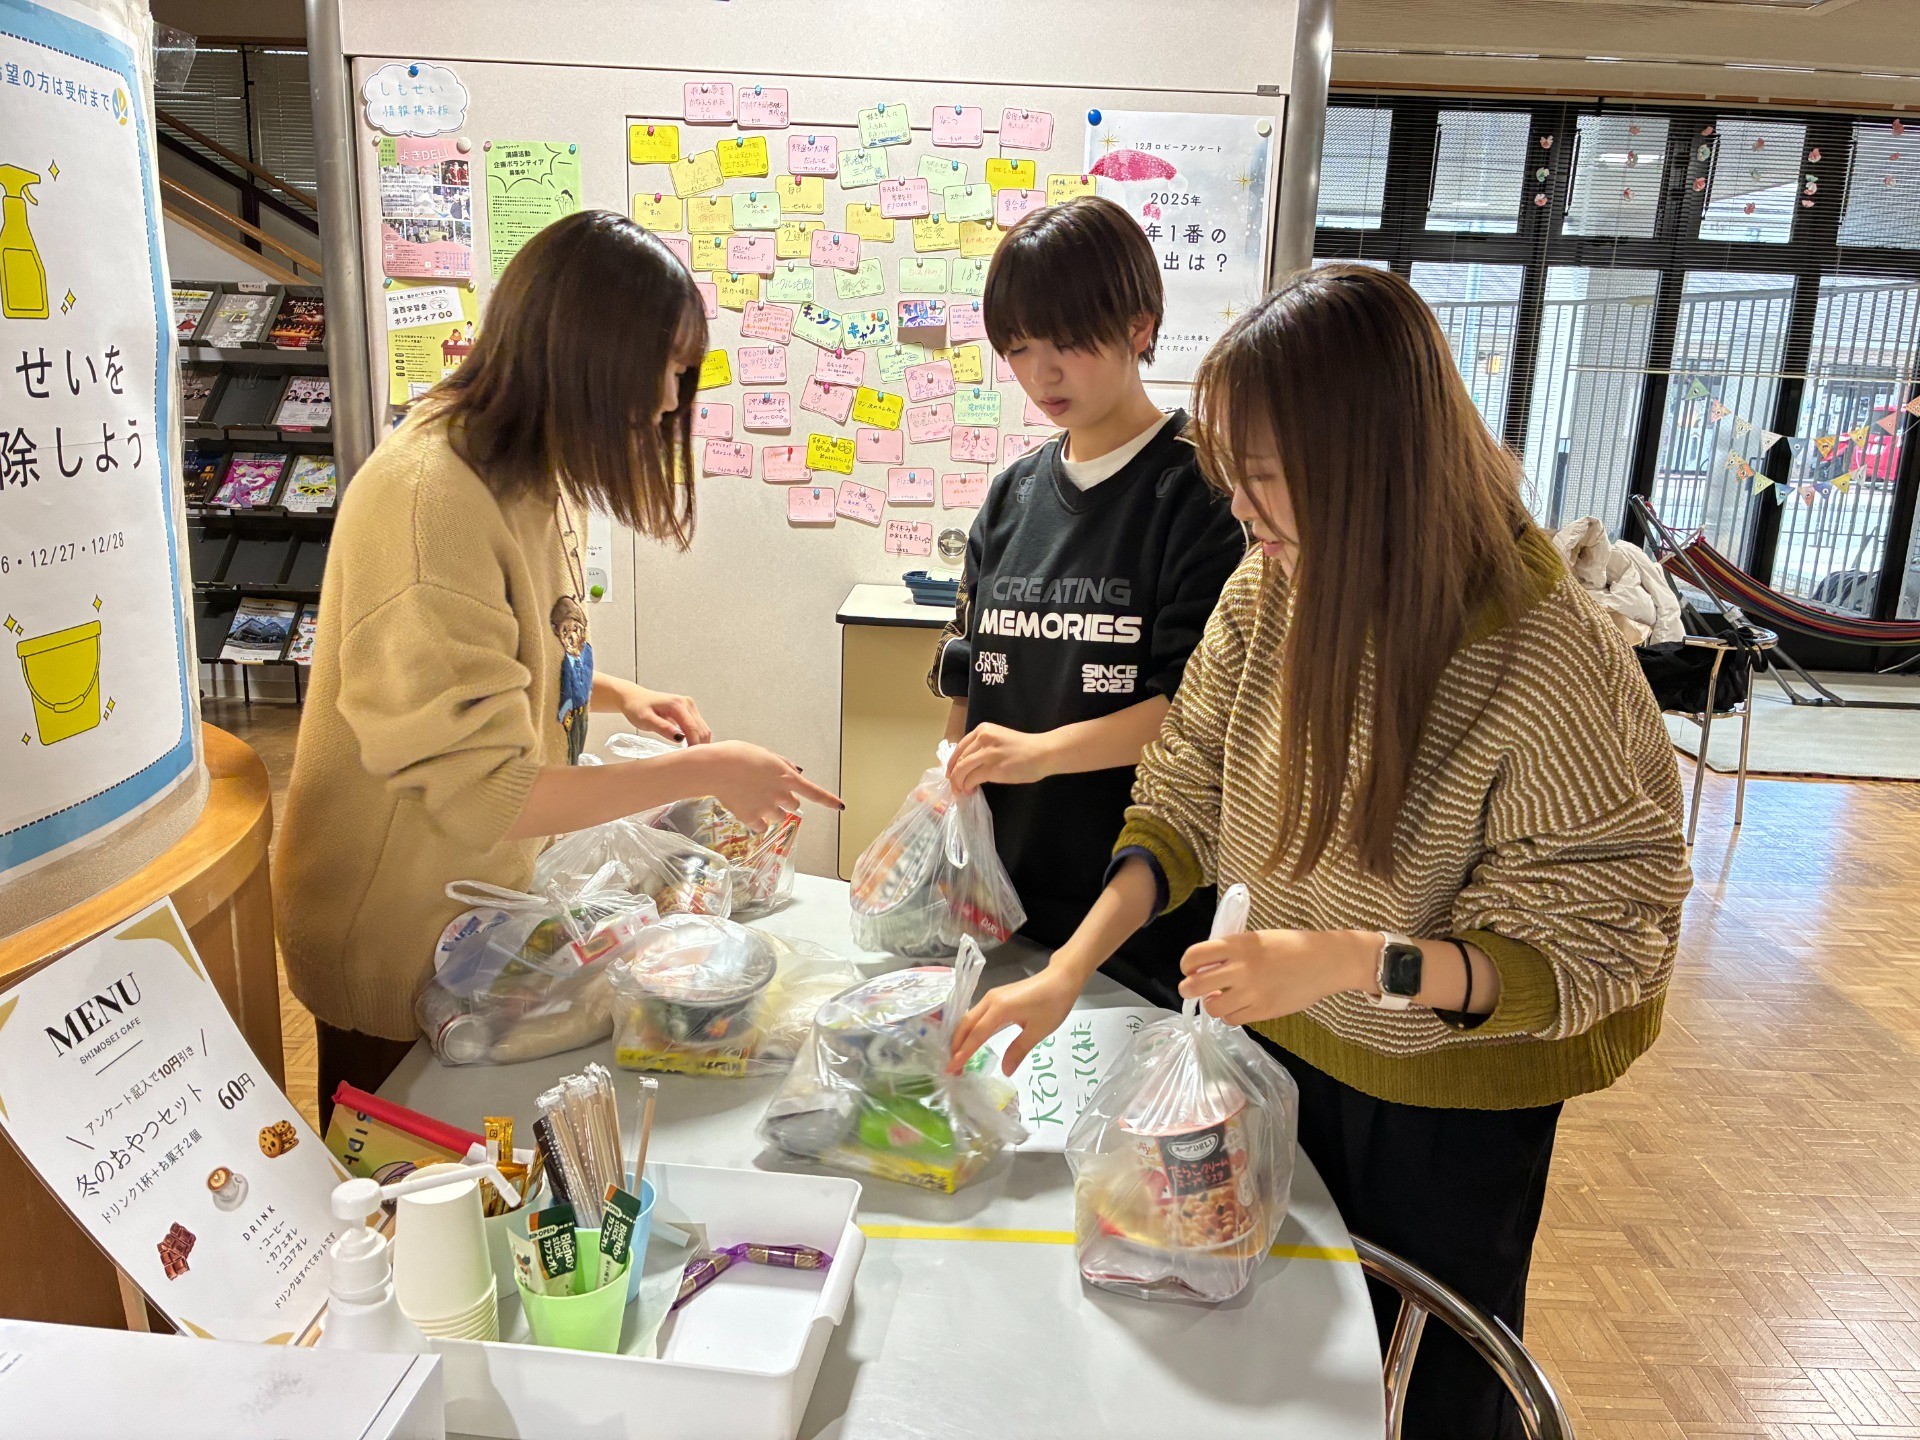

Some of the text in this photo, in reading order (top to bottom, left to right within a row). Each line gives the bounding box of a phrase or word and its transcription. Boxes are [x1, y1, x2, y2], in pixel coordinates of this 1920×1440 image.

[380, 82, 443, 96] しもせい
[382, 104, 450, 117] 情報掲示板
[1135, 142, 1223, 154] 12月ロビーアンケート
[1150, 192, 1202, 206] 2025年
[16, 345, 125, 399] せいを
[992, 575, 1132, 606] CREATING
[978, 608, 1143, 644] MEMORIES
[974, 661, 1009, 676] ON THE
[978, 651, 1007, 665] FOCUS
[1081, 663, 1138, 679] SINCE
[1082, 678, 1135, 693] 2023
[44, 971, 141, 1057] MENU
[79, 1016, 142, 1065] SHIMOSEI CAFE
[85, 1046, 195, 1136] アンケート記入で10円引き
[217, 1072, 256, 1110] 60円
[76, 1083, 202, 1198] 冬のおやつセット
[242, 1205, 276, 1241] DRINK
[607, 1204, 621, 1217] OPEN
[538, 1226, 556, 1238] OPEN
[600, 1215, 614, 1251] カフェオレ
[611, 1219, 619, 1242] stick
[612, 1223, 628, 1259] Blendy
[542, 1239, 558, 1274] カフェオレ
[552, 1236, 563, 1259] stick
[560, 1233, 575, 1269] Blendy
[274, 1232, 337, 1309] ドリンクはすべてホットです
